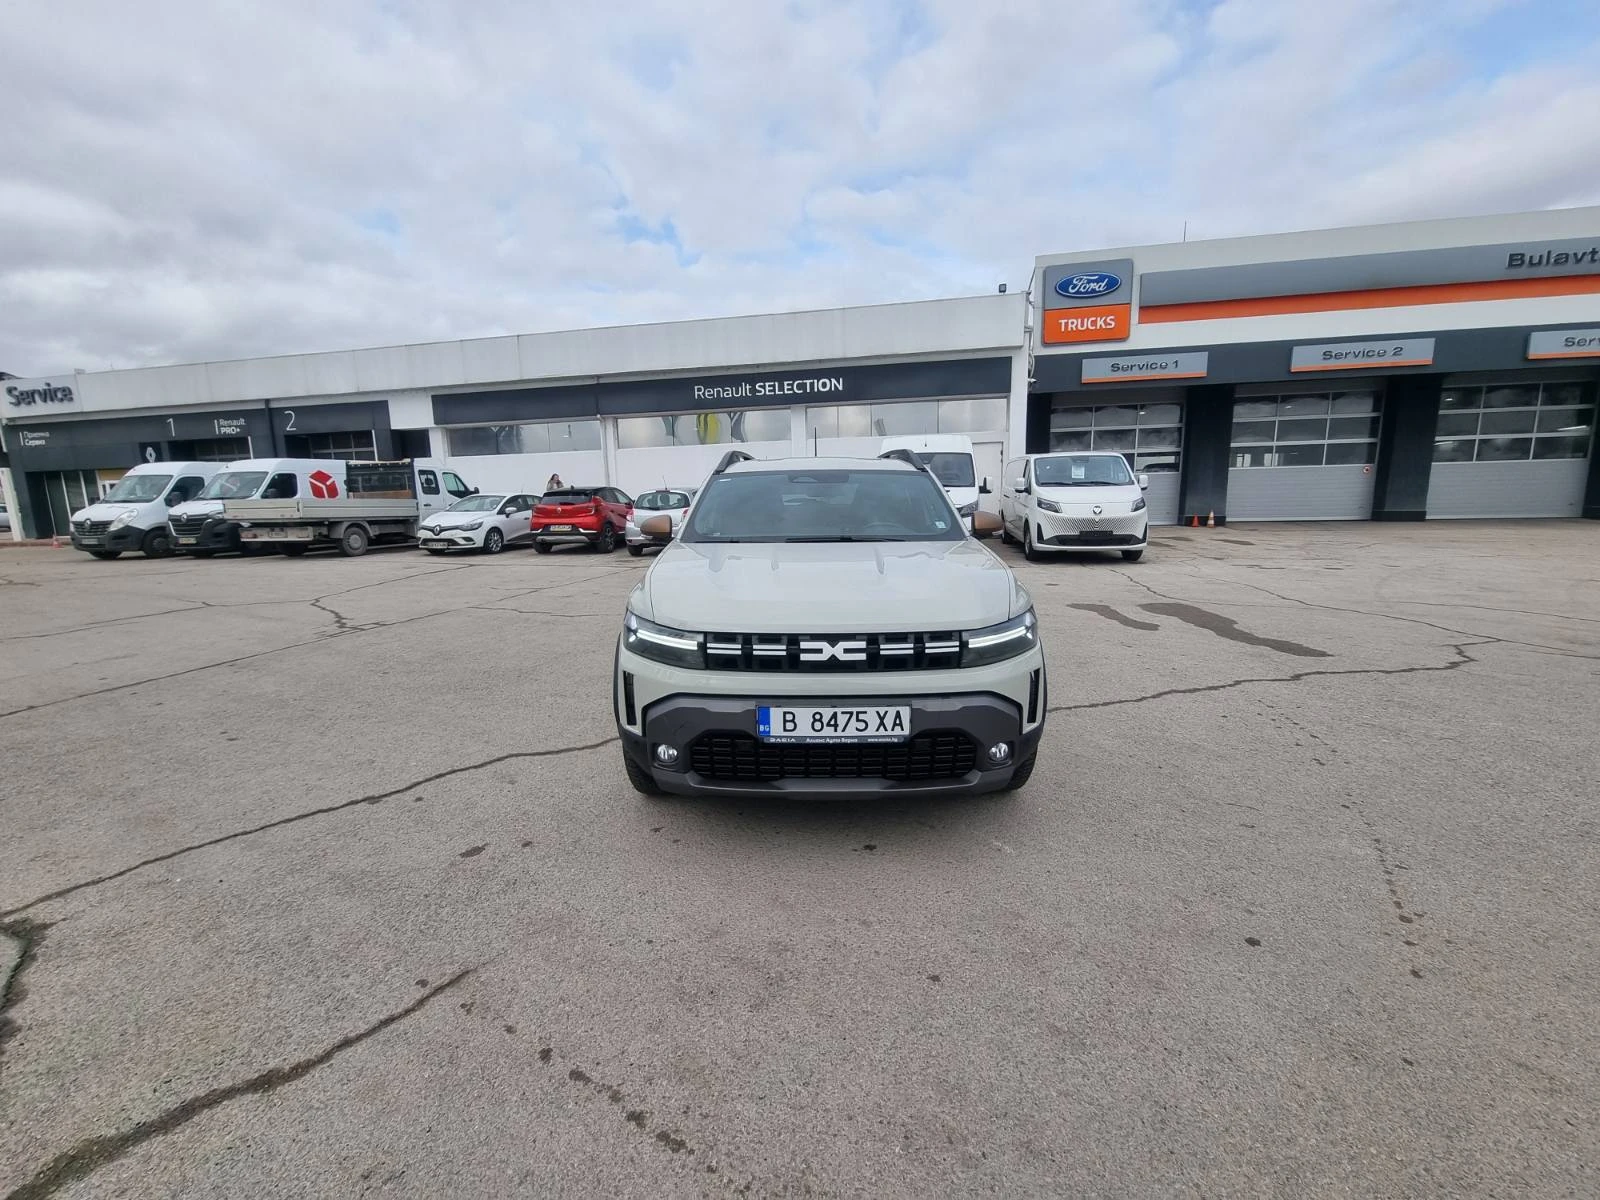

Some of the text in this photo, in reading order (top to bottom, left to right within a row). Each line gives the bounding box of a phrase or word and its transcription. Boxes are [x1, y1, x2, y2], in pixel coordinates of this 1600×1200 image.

[1506, 246, 1600, 270] Bulavt
[1068, 274, 1109, 294] Ford
[1058, 315, 1116, 332] TRUCKS
[1321, 346, 1404, 362] Service 2
[1110, 359, 1180, 373] Service 1
[6, 382, 74, 406] Service
[694, 377, 844, 399] Renault SELECTION
[166, 417, 176, 437] 1
[218, 417, 247, 426] Renault
[284, 409, 297, 431] 2
[759, 724, 770, 732] BG
[783, 710, 905, 733] B 8475 XA
